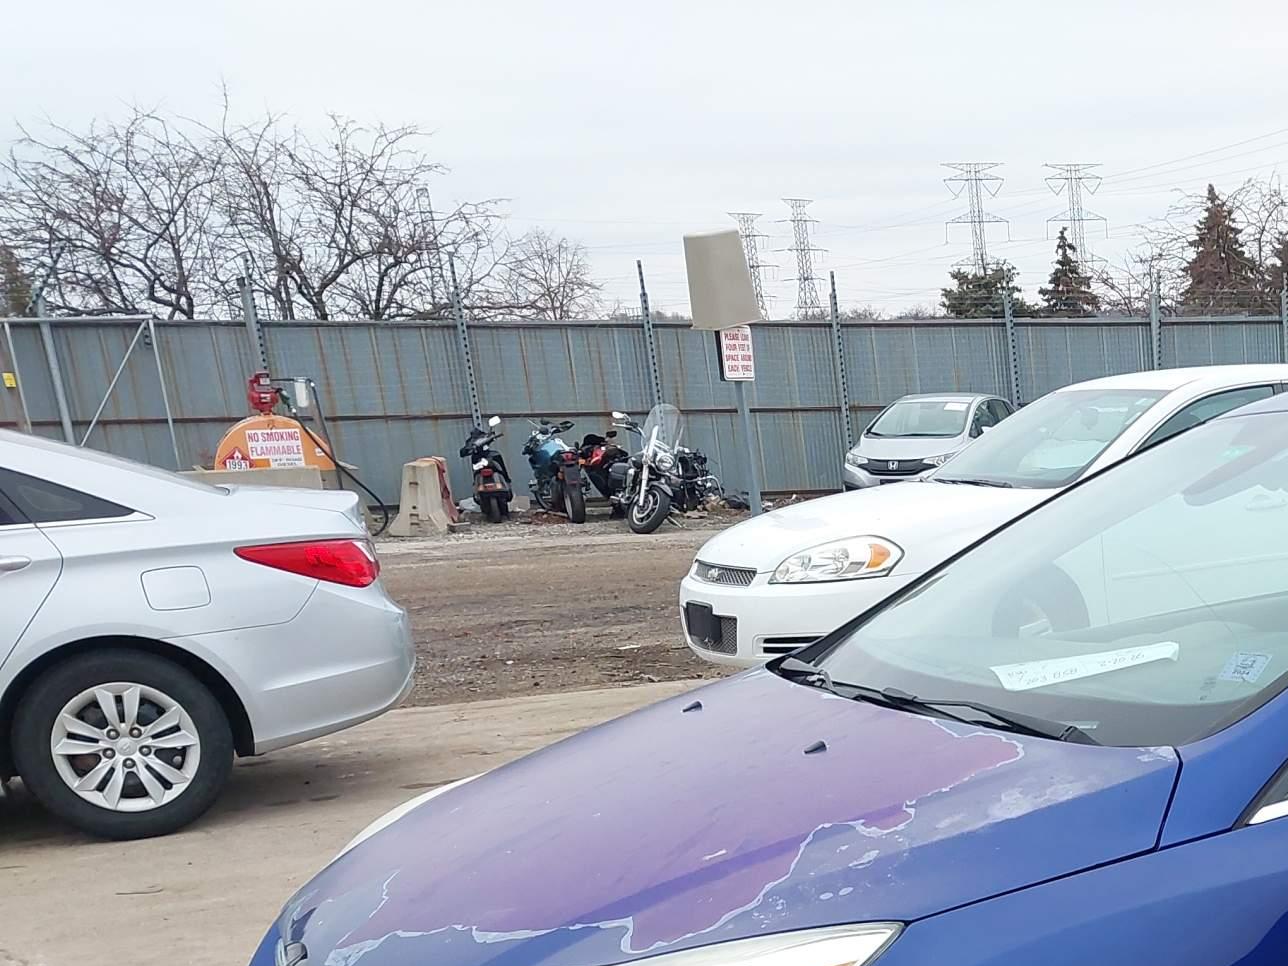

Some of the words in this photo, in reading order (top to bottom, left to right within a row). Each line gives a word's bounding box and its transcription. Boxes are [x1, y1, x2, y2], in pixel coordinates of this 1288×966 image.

[247, 432, 260, 443] NO
[260, 430, 299, 442] SMOKING
[250, 445, 302, 457] FLAMMABLE
[228, 460, 249, 470] 1993
